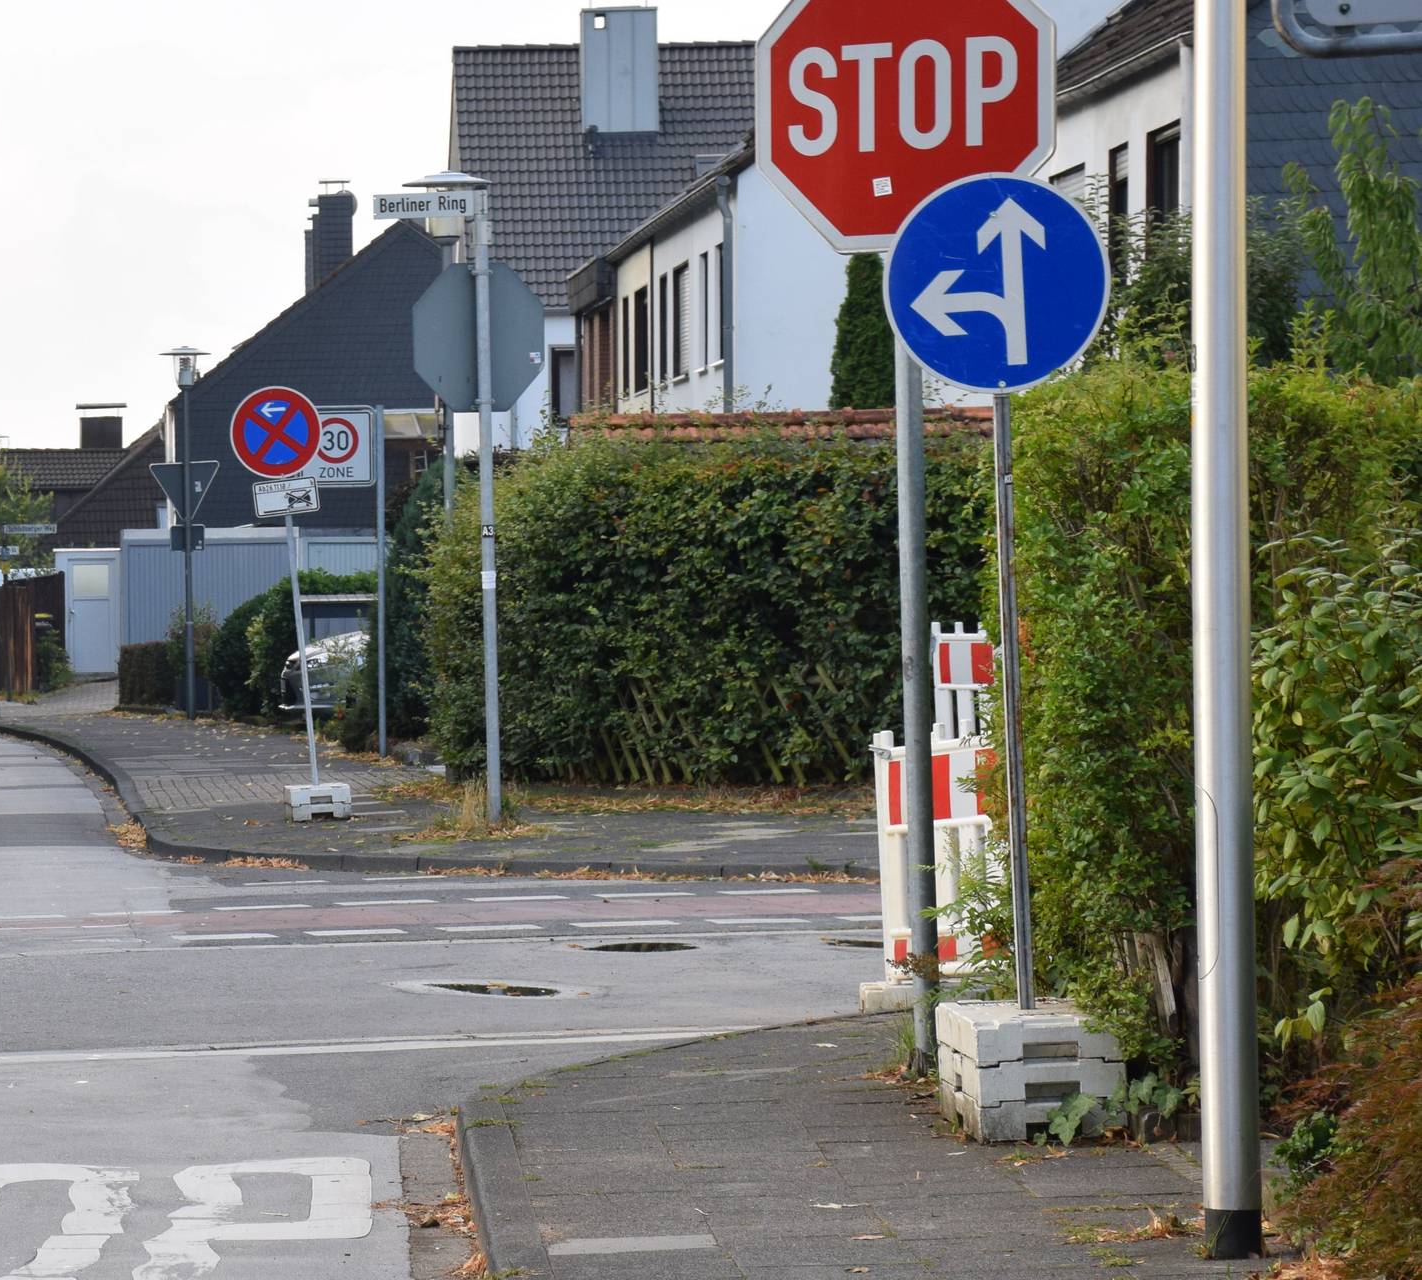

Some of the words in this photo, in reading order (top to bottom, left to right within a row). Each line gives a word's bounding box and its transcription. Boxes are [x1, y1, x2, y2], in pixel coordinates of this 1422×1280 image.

[788, 35, 1018, 156] STOP
[379, 197, 431, 213] Berliner
[438, 195, 466, 213] Ring
[322, 430, 349, 451] 30
[319, 466, 354, 479] ZONE
